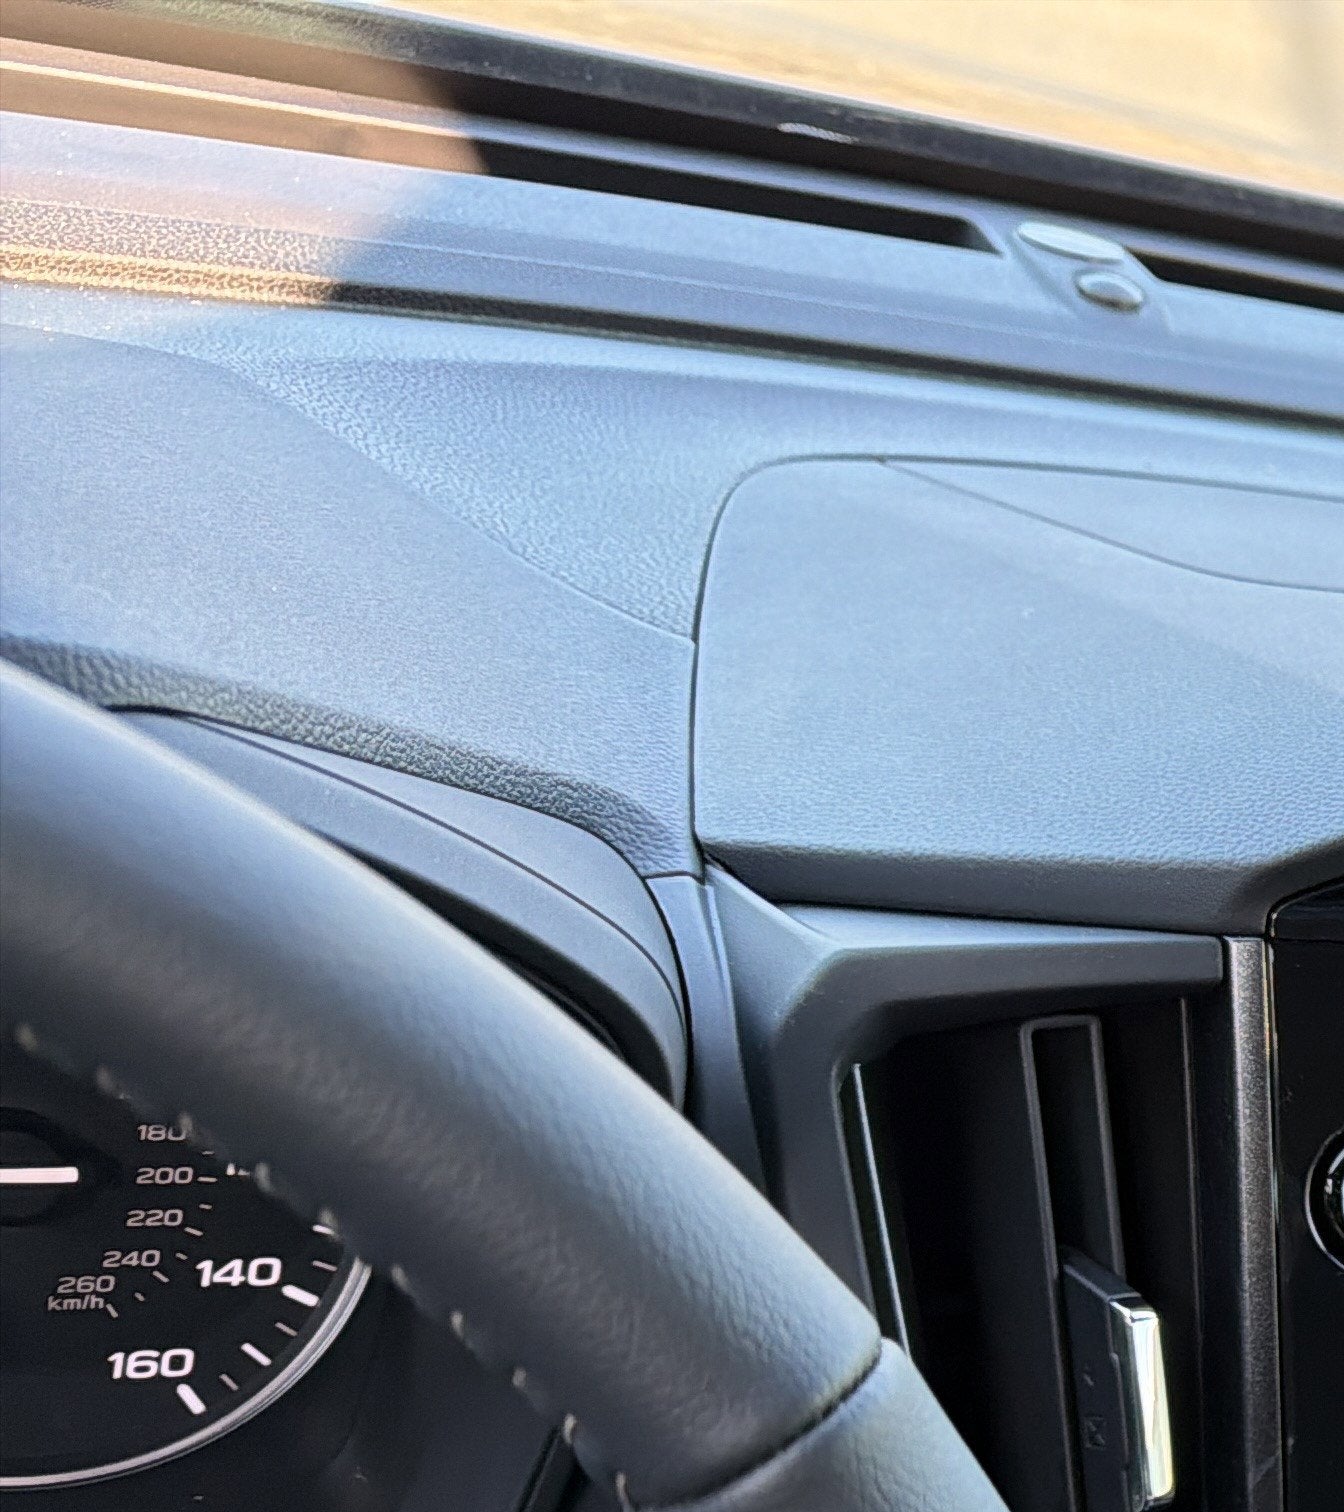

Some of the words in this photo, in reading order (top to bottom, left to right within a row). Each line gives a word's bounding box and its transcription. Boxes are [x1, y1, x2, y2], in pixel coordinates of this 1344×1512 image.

[136, 1167, 193, 1184] 200
[127, 1209, 183, 1227] 220
[103, 1250, 160, 1267] 240
[196, 1257, 282, 1287] 140
[57, 1275, 115, 1293] 260
[48, 1295, 105, 1311] km/h
[108, 1349, 194, 1379] 160
